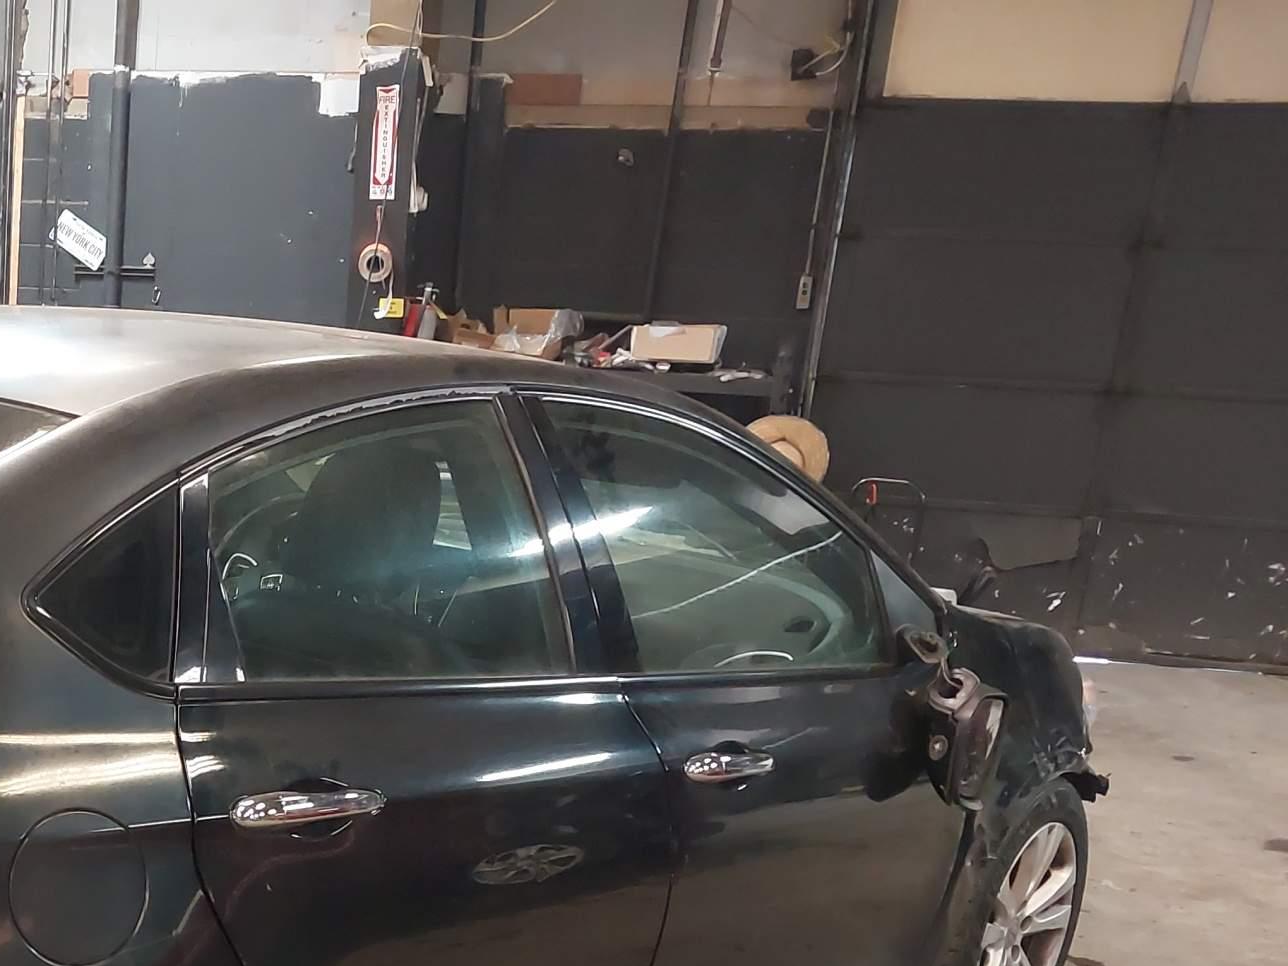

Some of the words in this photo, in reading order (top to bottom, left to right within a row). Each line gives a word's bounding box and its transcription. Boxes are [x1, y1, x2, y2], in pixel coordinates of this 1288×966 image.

[378, 95, 396, 104] FIRE
[58, 221, 73, 238] NEW
[72, 231, 90, 249] YORK
[87, 243, 104, 260] CITY
